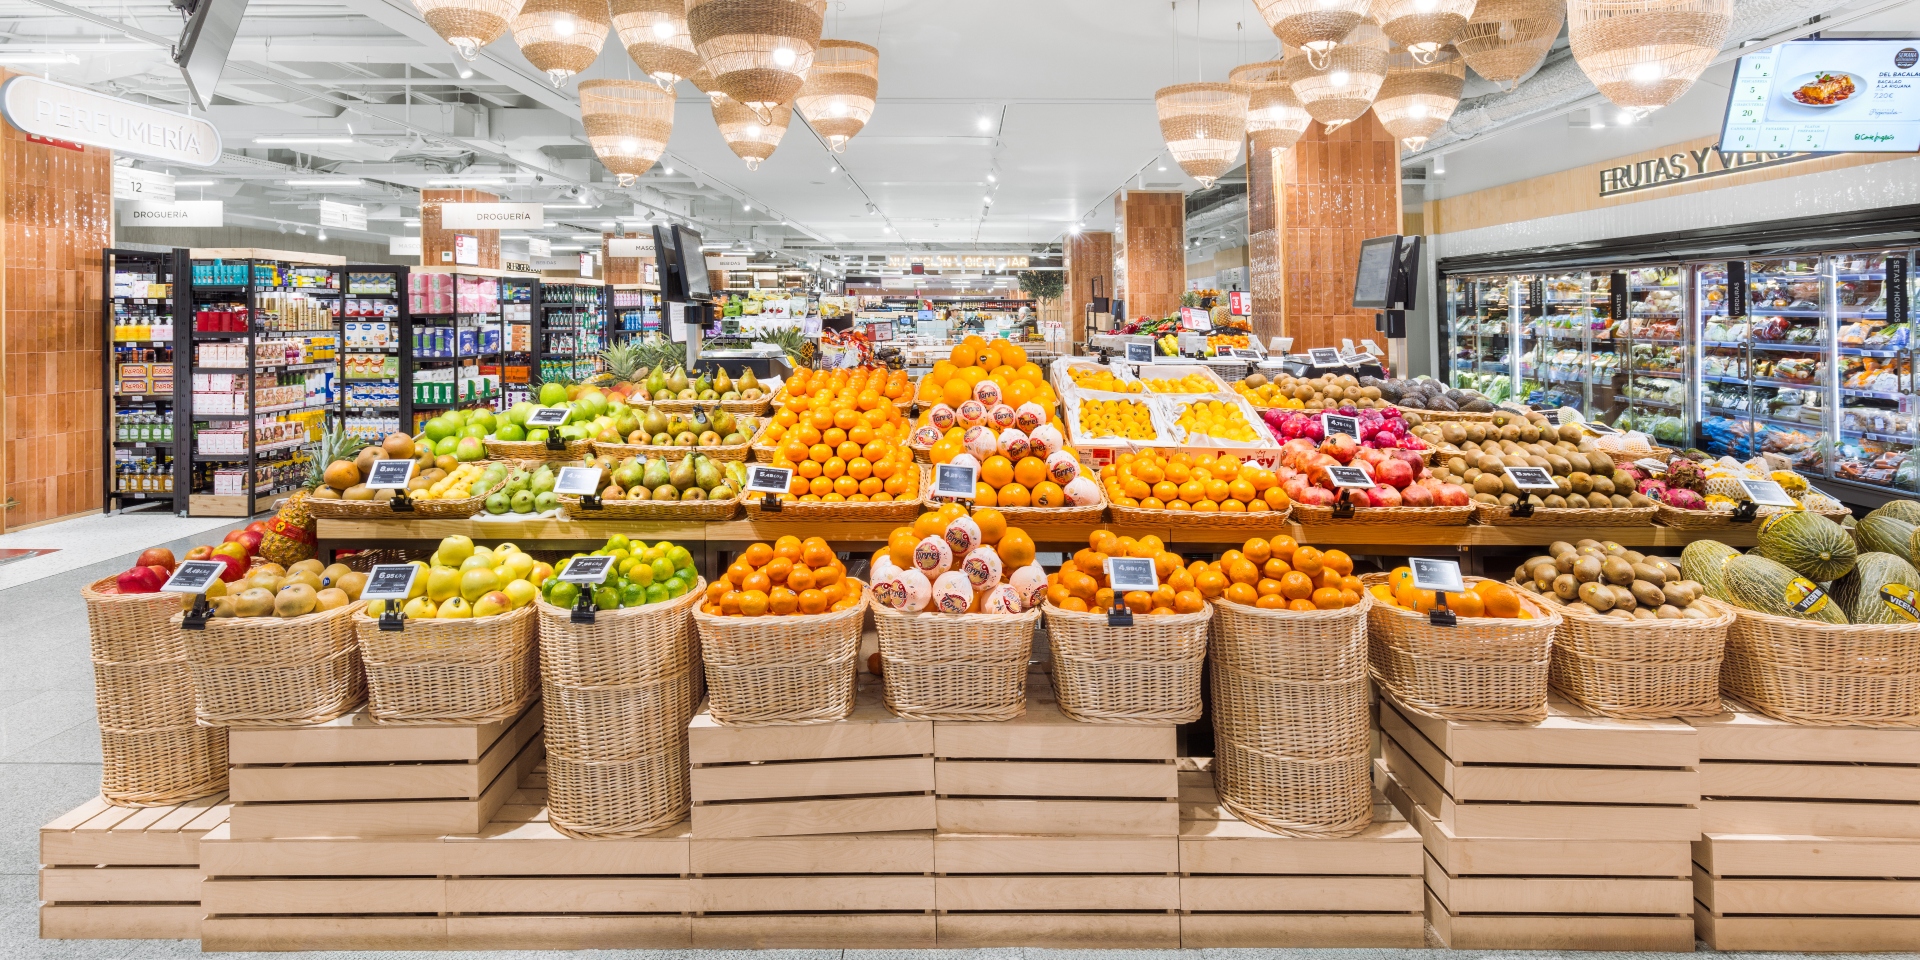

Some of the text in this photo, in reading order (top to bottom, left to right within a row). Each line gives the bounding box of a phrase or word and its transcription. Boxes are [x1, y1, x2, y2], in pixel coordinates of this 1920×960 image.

[35, 98, 201, 155] PERFUMERÍA
[1600, 153, 1688, 193] FRUTAS
[1690, 147, 1712, 174] Y
[131, 181, 142, 193] 12
[133, 210, 188, 219] DROGUERÍA
[342, 213, 348, 222] 11
[476, 211, 531, 221] DROGUERÍA
[1244, 304, 1251, 312] 2
[945, 528, 970, 549] Torres
[915, 549, 941, 560] Torres
[964, 559, 989, 580] Torres
